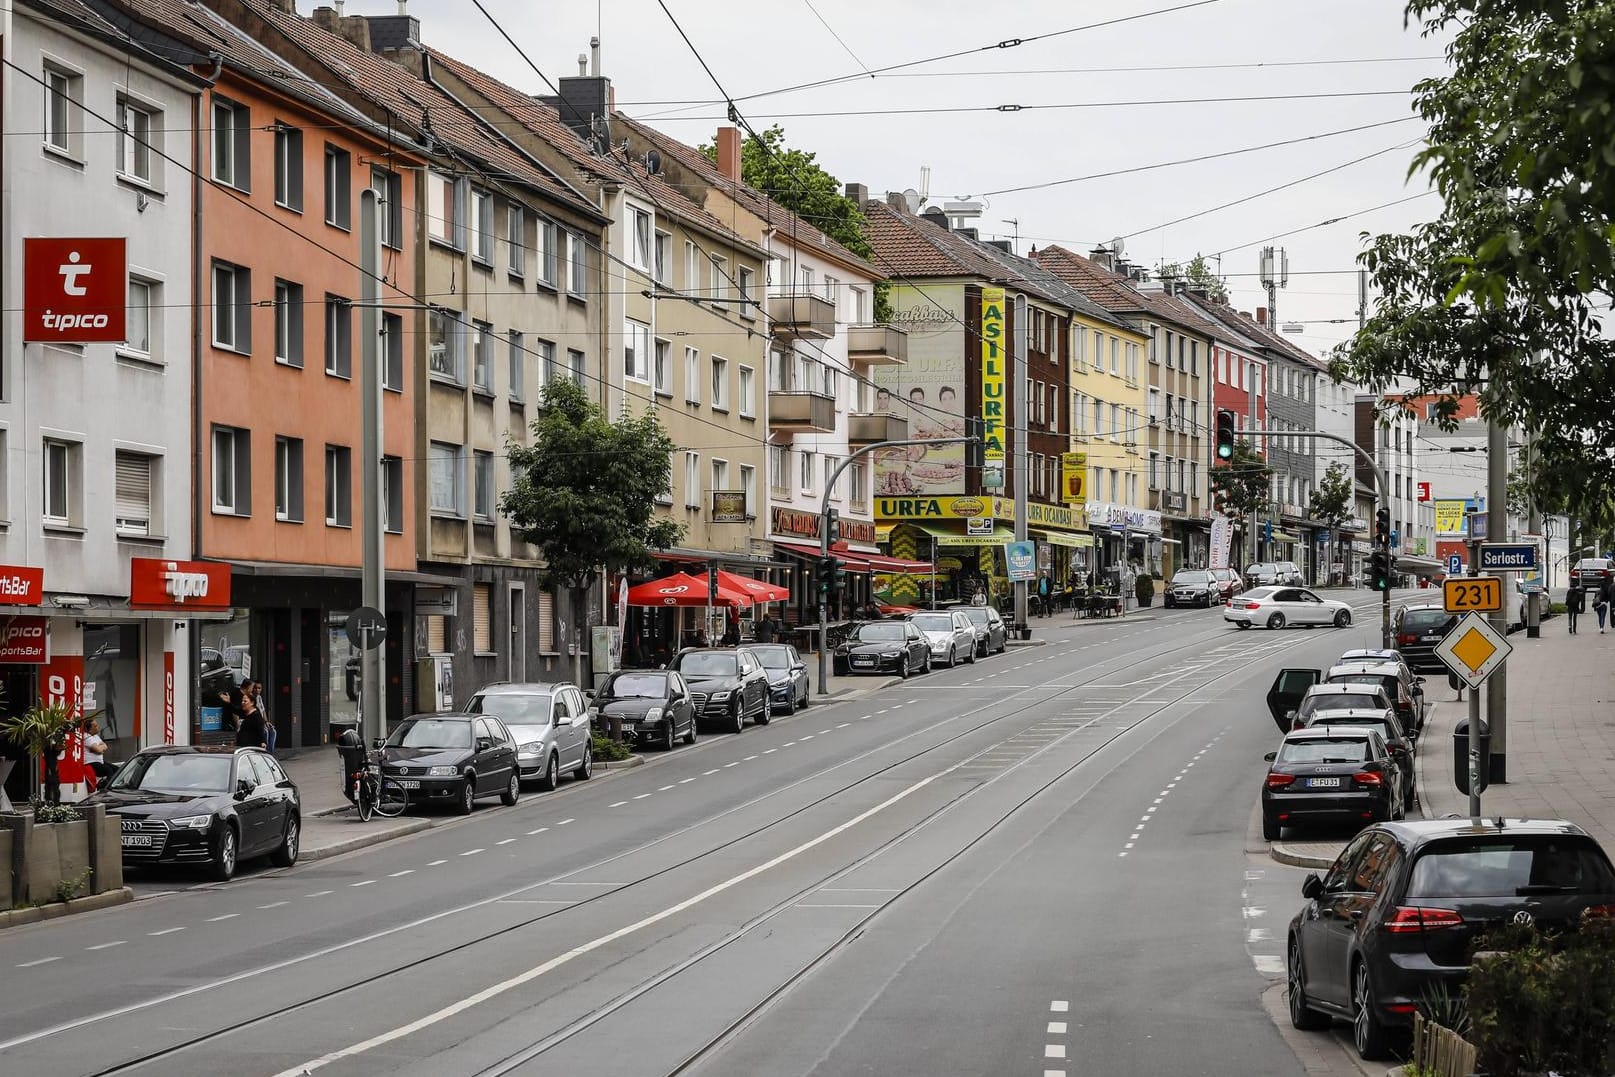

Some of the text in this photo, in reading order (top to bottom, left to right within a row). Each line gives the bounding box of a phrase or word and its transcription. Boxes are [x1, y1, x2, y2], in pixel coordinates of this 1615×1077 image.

[42, 309, 109, 332] tipico
[881, 499, 942, 516] URFA
[1484, 551, 1528, 565] Serlostr.
[1455, 585, 1492, 606] 231
